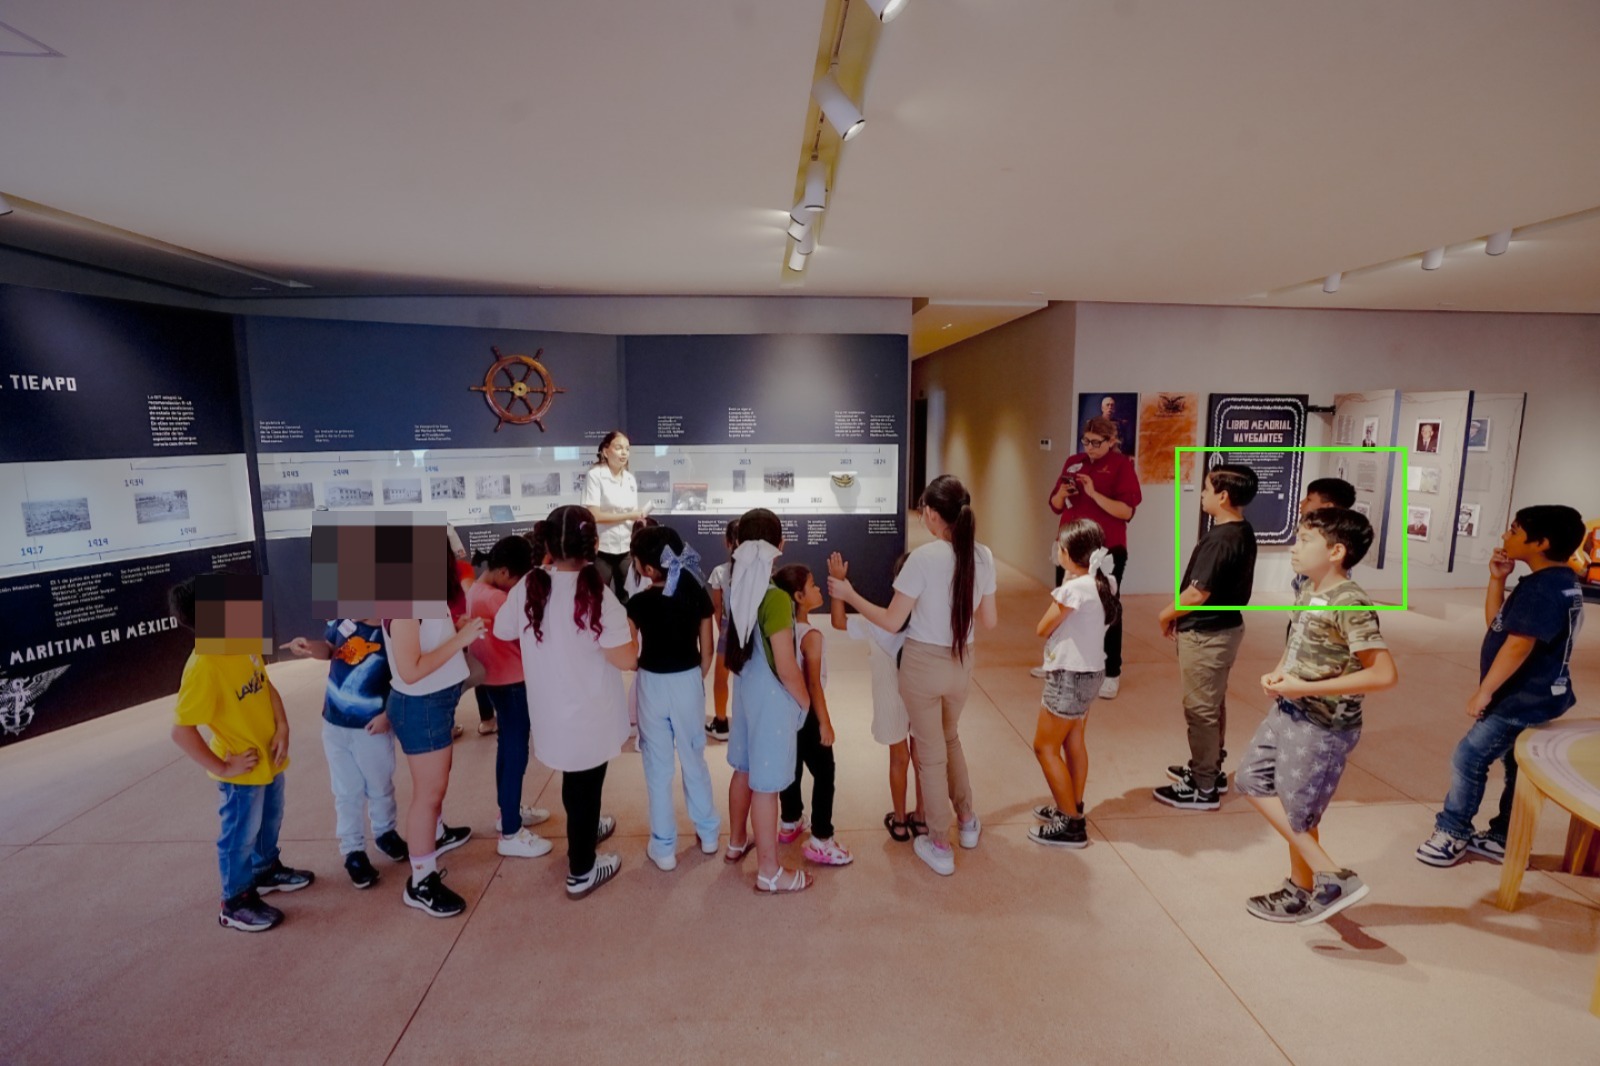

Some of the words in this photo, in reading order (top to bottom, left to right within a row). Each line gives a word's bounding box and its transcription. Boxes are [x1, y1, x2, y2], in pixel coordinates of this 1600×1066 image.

[9, 374, 77, 392] TIEMPO
[1226, 419, 1250, 431] LIBRO
[1251, 419, 1292, 431] MEMORIAL
[1233, 432, 1284, 443] NAVEGANTES
[21, 545, 43, 556] 1917
[10, 634, 97, 666] MARÍTIMA
[101, 628, 121, 645] EN
[127, 615, 179, 640] MÉXICO
